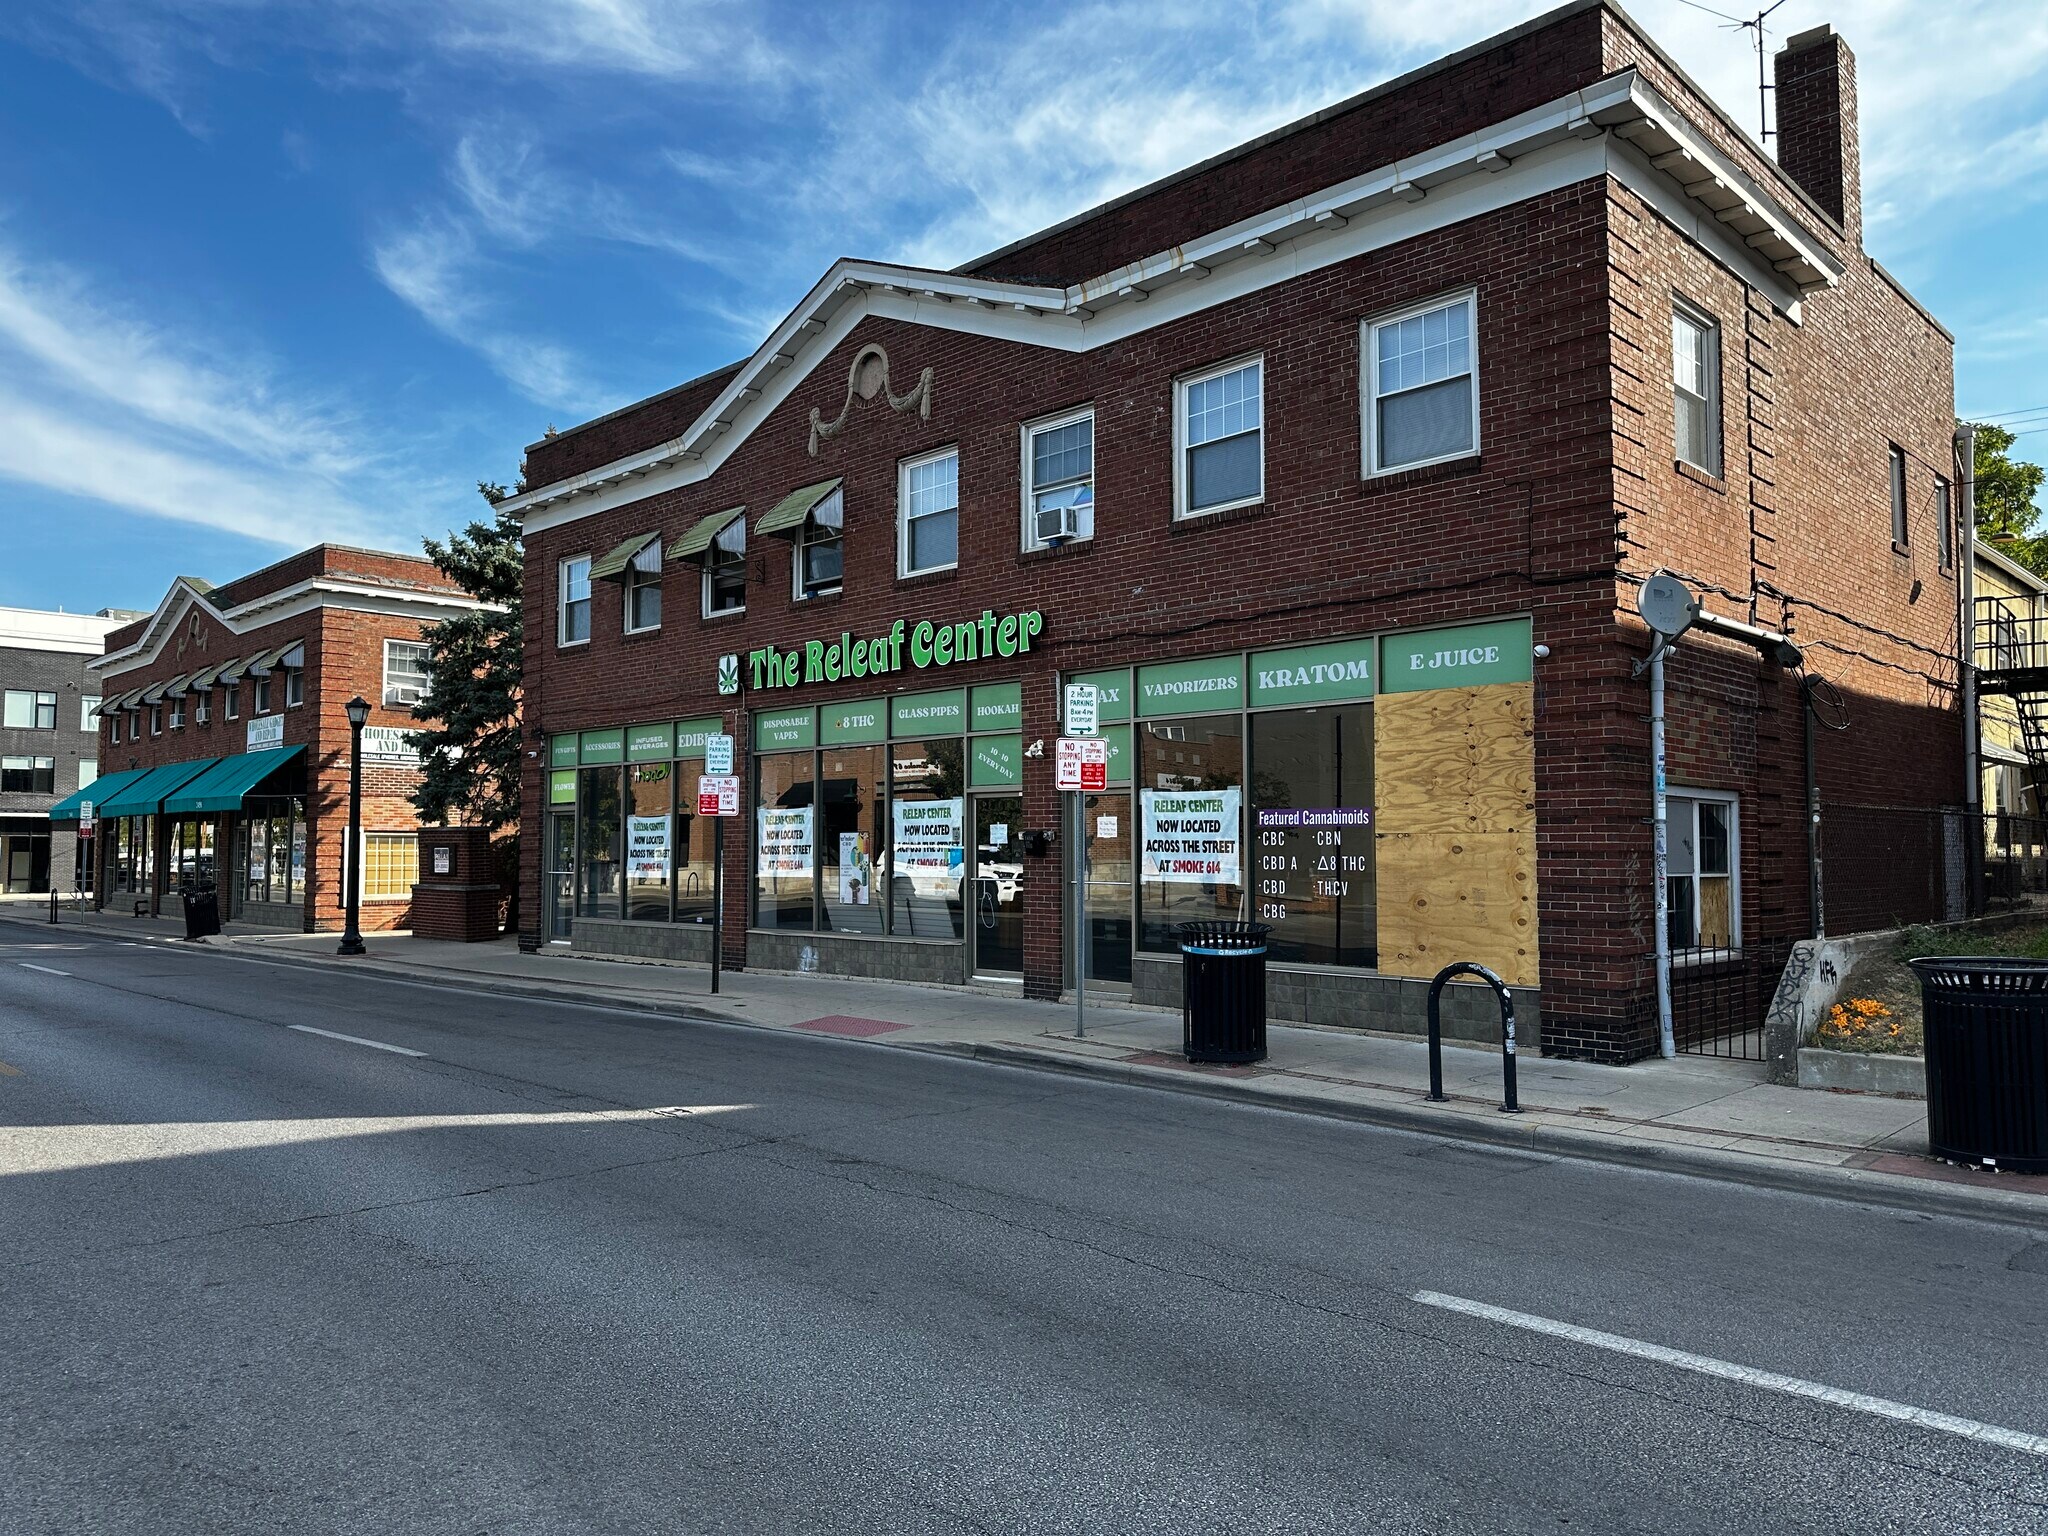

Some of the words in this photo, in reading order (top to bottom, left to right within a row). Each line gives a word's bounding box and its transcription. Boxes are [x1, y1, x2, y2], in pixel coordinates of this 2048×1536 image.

[750, 646, 799, 689] The
[804, 619, 904, 682] Releaf
[911, 610, 1042, 668] Center
[1410, 654, 1424, 670] E
[1428, 646, 1499, 669] JUICE
[1258, 660, 1369, 690] KRATOM
[1144, 676, 1238, 697] VAPORIZERS
[1098, 688, 1120, 703] AX
[898, 707, 929, 719] GLASS
[930, 705, 959, 717] PIPES
[977, 704, 1019, 716] HOOKAH
[763, 716, 810, 729] DISPOSABLE
[852, 715, 875, 727] THC
[636, 736, 663, 744] INFUSED
[774, 731, 799, 741] VAPES
[376, 741, 398, 752] AND
[585, 742, 621, 752] ACCESSORIES
[631, 742, 669, 751] BEVERAGES
[1065, 743, 1075, 751] NO
[990, 746, 998, 756] 10
[1001, 753, 1009, 762] 10
[1059, 752, 1081, 760] STOPPING
[978, 752, 1000, 770] EVERY
[999, 766, 1015, 779] DAY
[554, 782, 576, 791] FLOWER
[1154, 800, 1187, 813] RELEAF
[1188, 799, 1224, 813] CENTER
[765, 815, 785, 826] RELEAF
[785, 814, 805, 825] CENTER
[903, 809, 926, 820] RELEAF
[927, 808, 951, 819] CENTER
[1259, 811, 1300, 825] Featured
[1302, 809, 1369, 825] Cannabinoids
[633, 822, 649, 833] RELEAF
[648, 821, 666, 832] CENTER
[904, 825, 920, 836] NOW
[921, 824, 950, 836] LOCATED
[1156, 820, 1179, 833] NOW
[1180, 819, 1221, 833] LOCATED
[633, 836, 646, 845] NOW
[645, 835, 665, 845] LOCATED
[766, 830, 780, 840] NOW
[781, 829, 804, 840] LOCATED
[1262, 831, 1285, 846] CBC
[1317, 830, 1342, 846] CBN
[761, 845, 781, 855] ACROSS
[781, 845, 792, 855] THE
[792, 844, 812, 855] STREET
[1146, 840, 1180, 853] ACROSS
[1182, 840, 1200, 853] THE
[1202, 840, 1235, 854] STREET
[629, 849, 646, 859] ACROSS
[646, 849, 655, 858] THE
[768, 861, 776, 870] AT
[907, 858, 916, 868] AT
[1159, 860, 1171, 873] AT
[1172, 860, 1204, 873] SMOKE
[1206, 861, 1221, 874] 614
[1263, 856, 1285, 870] CBD
[1290, 856, 1298, 870] A
[1341, 856, 1366, 871] THC
[1263, 879, 1286, 894] CBD
[1317, 881, 1349, 896] THCV
[1263, 904, 1286, 919] CBG
